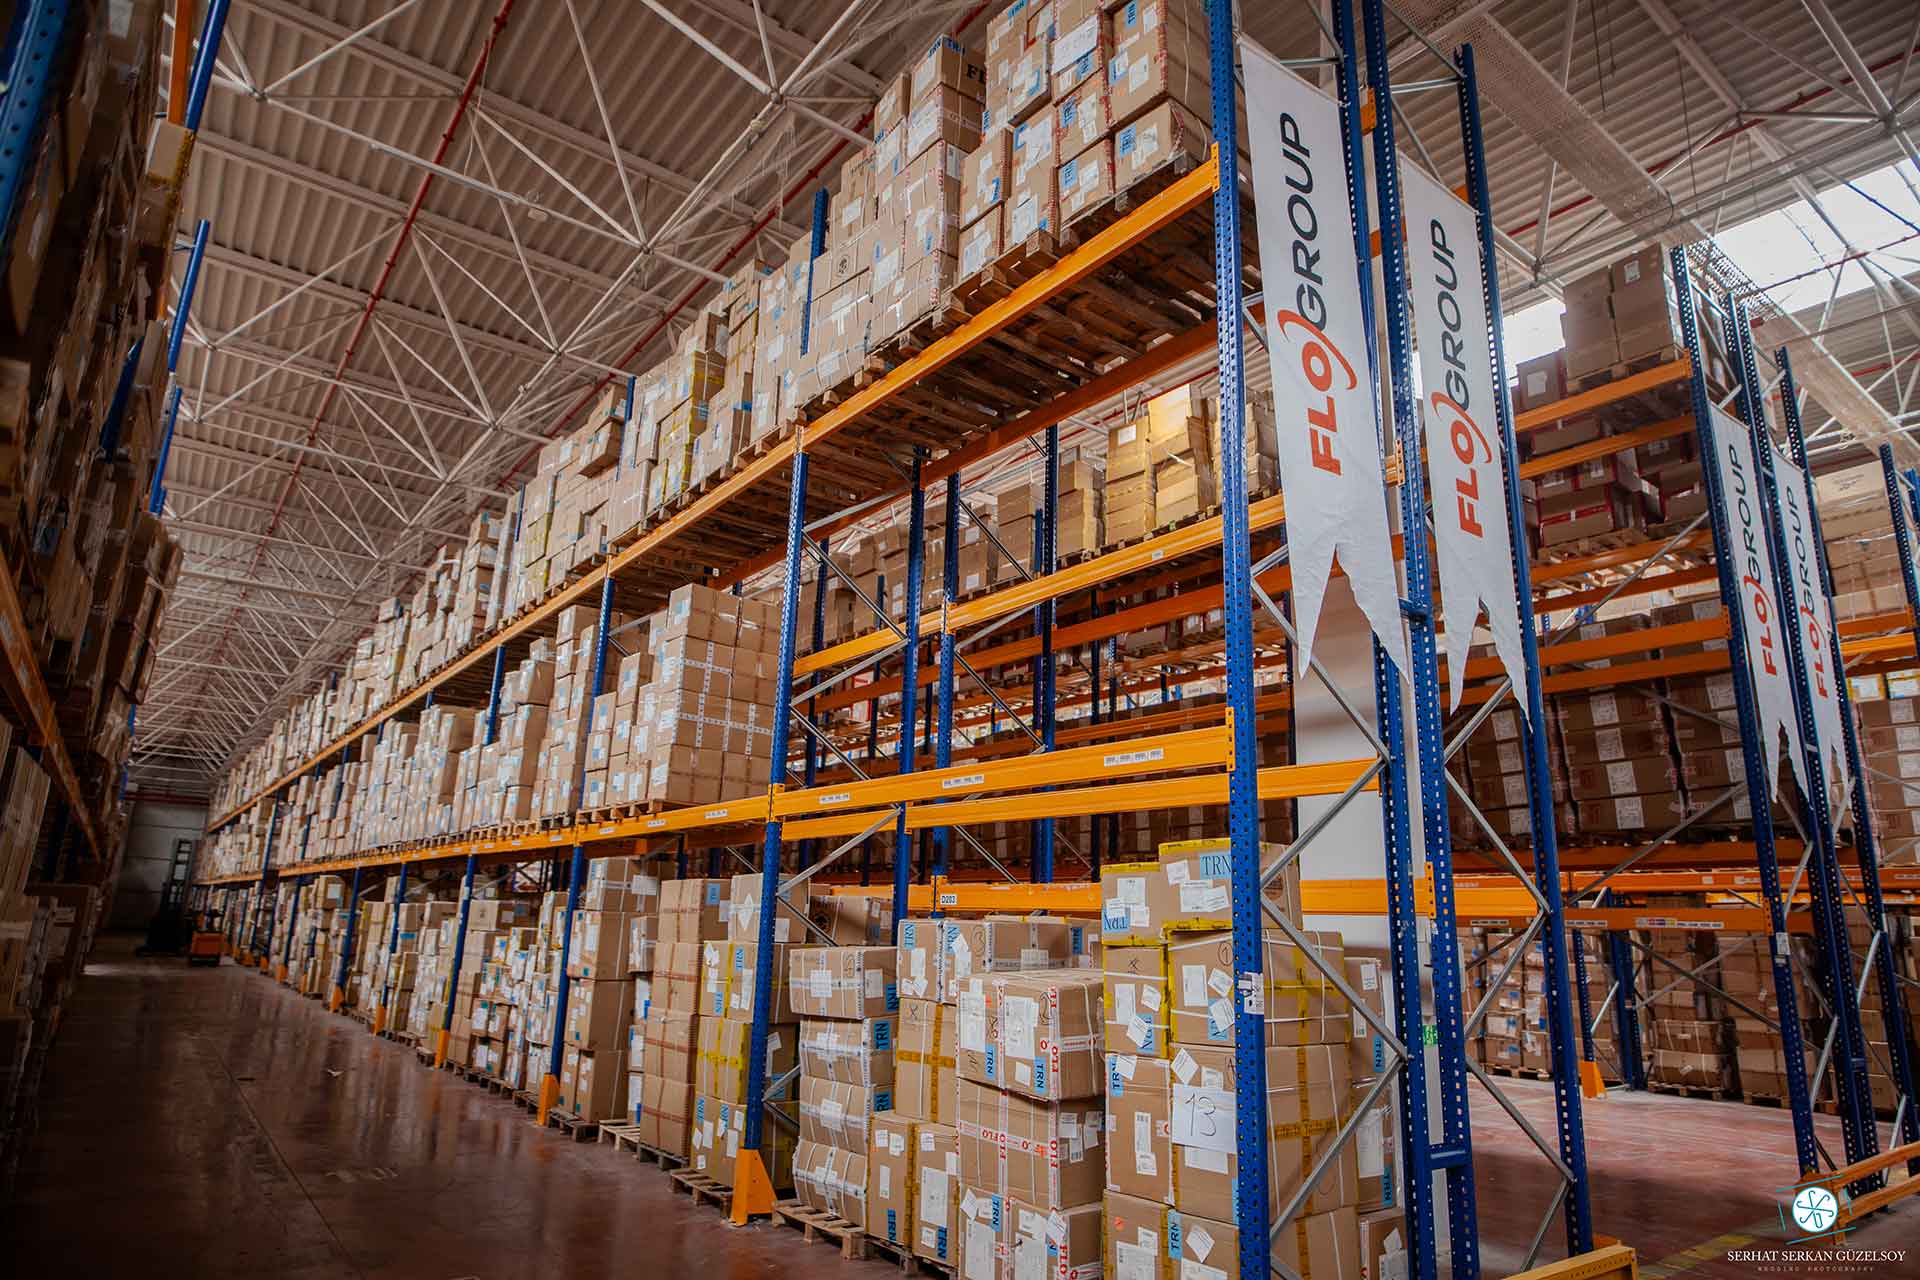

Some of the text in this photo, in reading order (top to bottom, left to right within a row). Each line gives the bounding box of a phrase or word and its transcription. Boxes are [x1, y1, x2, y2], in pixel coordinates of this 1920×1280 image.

[1202, 854, 1231, 876] TRN
[876, 1021, 889, 1050] TRN
[986, 1050, 994, 1075] TRN
[1051, 1047, 1059, 1073] FLO
[1036, 1063, 1045, 1089] TRN
[874, 1093, 889, 1112] RN
[1185, 1093, 1217, 1137] 13
[1050, 1140, 1058, 1169] FLO
[887, 1209, 897, 1242] TRN
[992, 1199, 1000, 1226] TRN
[938, 1227, 947, 1259] TRN
[1170, 1221, 1180, 1251] TRN
[1059, 1244, 1068, 1275] FLO
